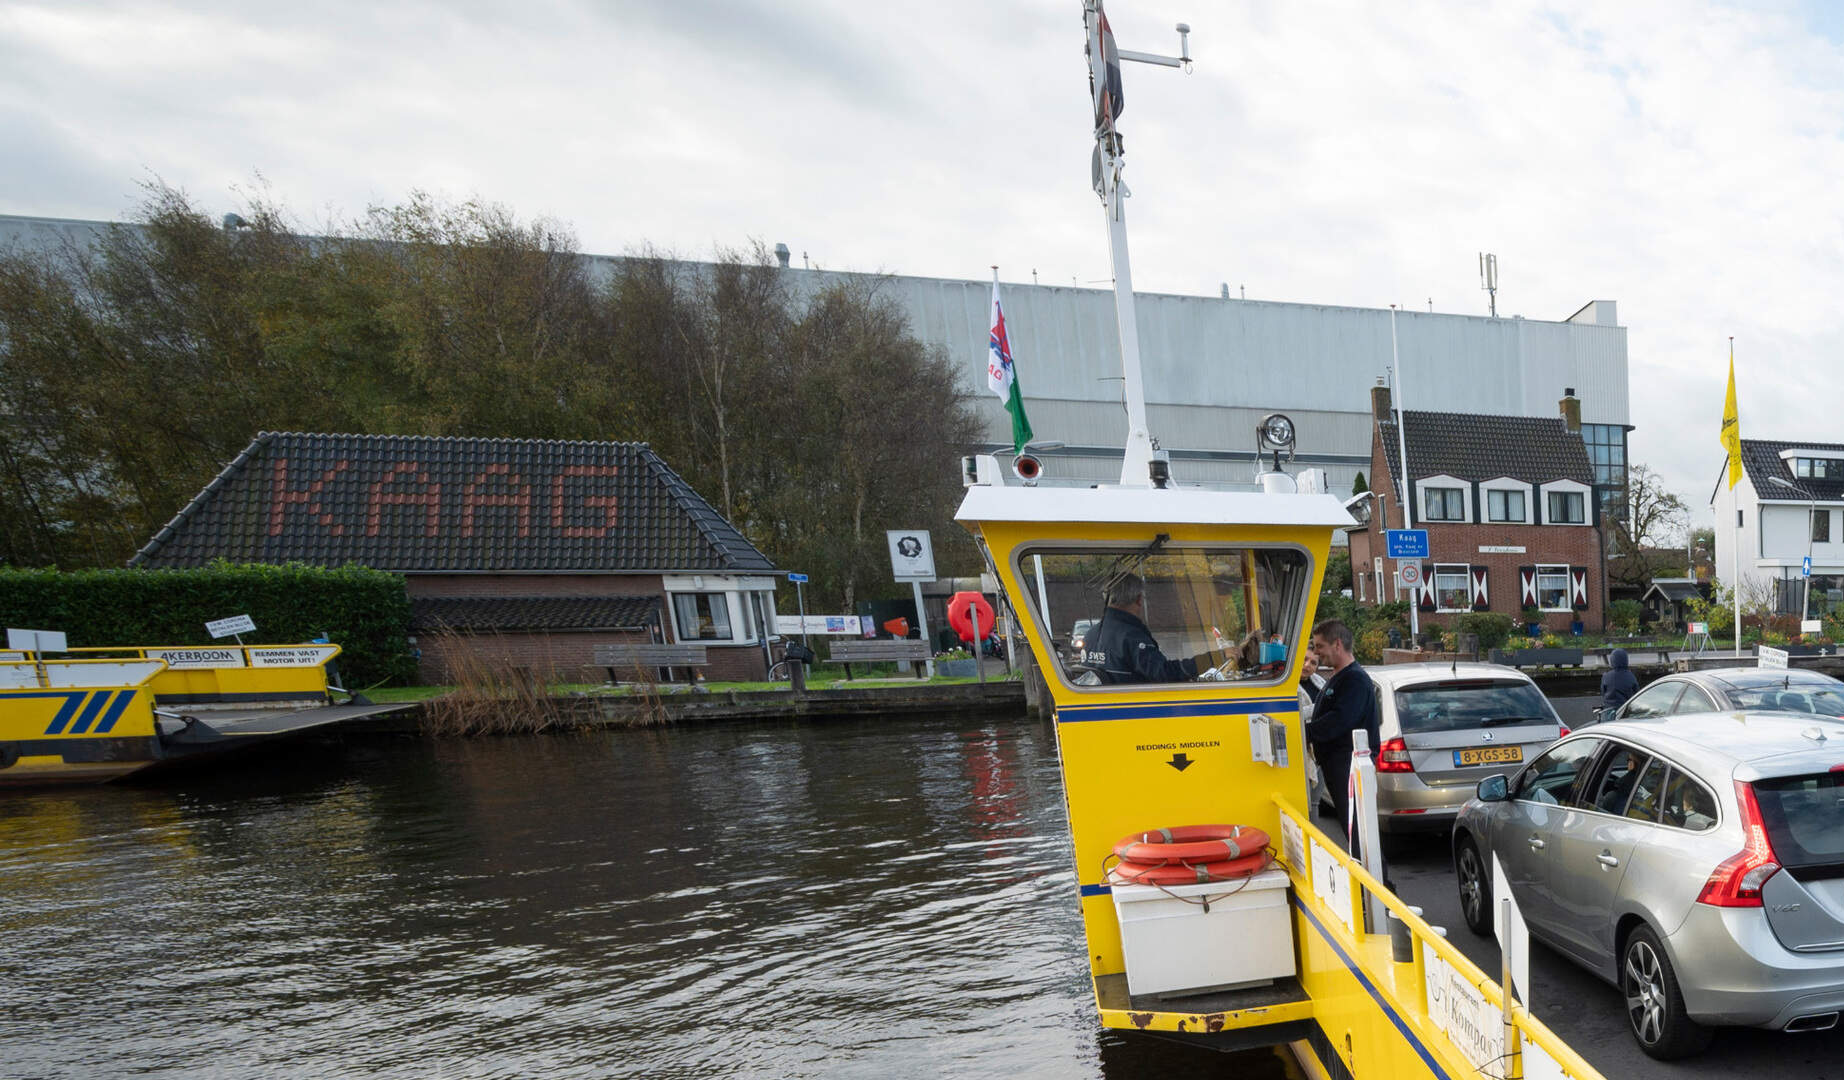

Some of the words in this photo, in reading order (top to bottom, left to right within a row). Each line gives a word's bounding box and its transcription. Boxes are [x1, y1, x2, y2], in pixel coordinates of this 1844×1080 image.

[269, 458, 618, 538] KAAG
[1405, 570, 1416, 578] 30
[1136, 743, 1177, 751] REDDINGS
[1179, 741, 1221, 749] MIDDELEN
[1463, 748, 1518, 763] 8-XGS-58
